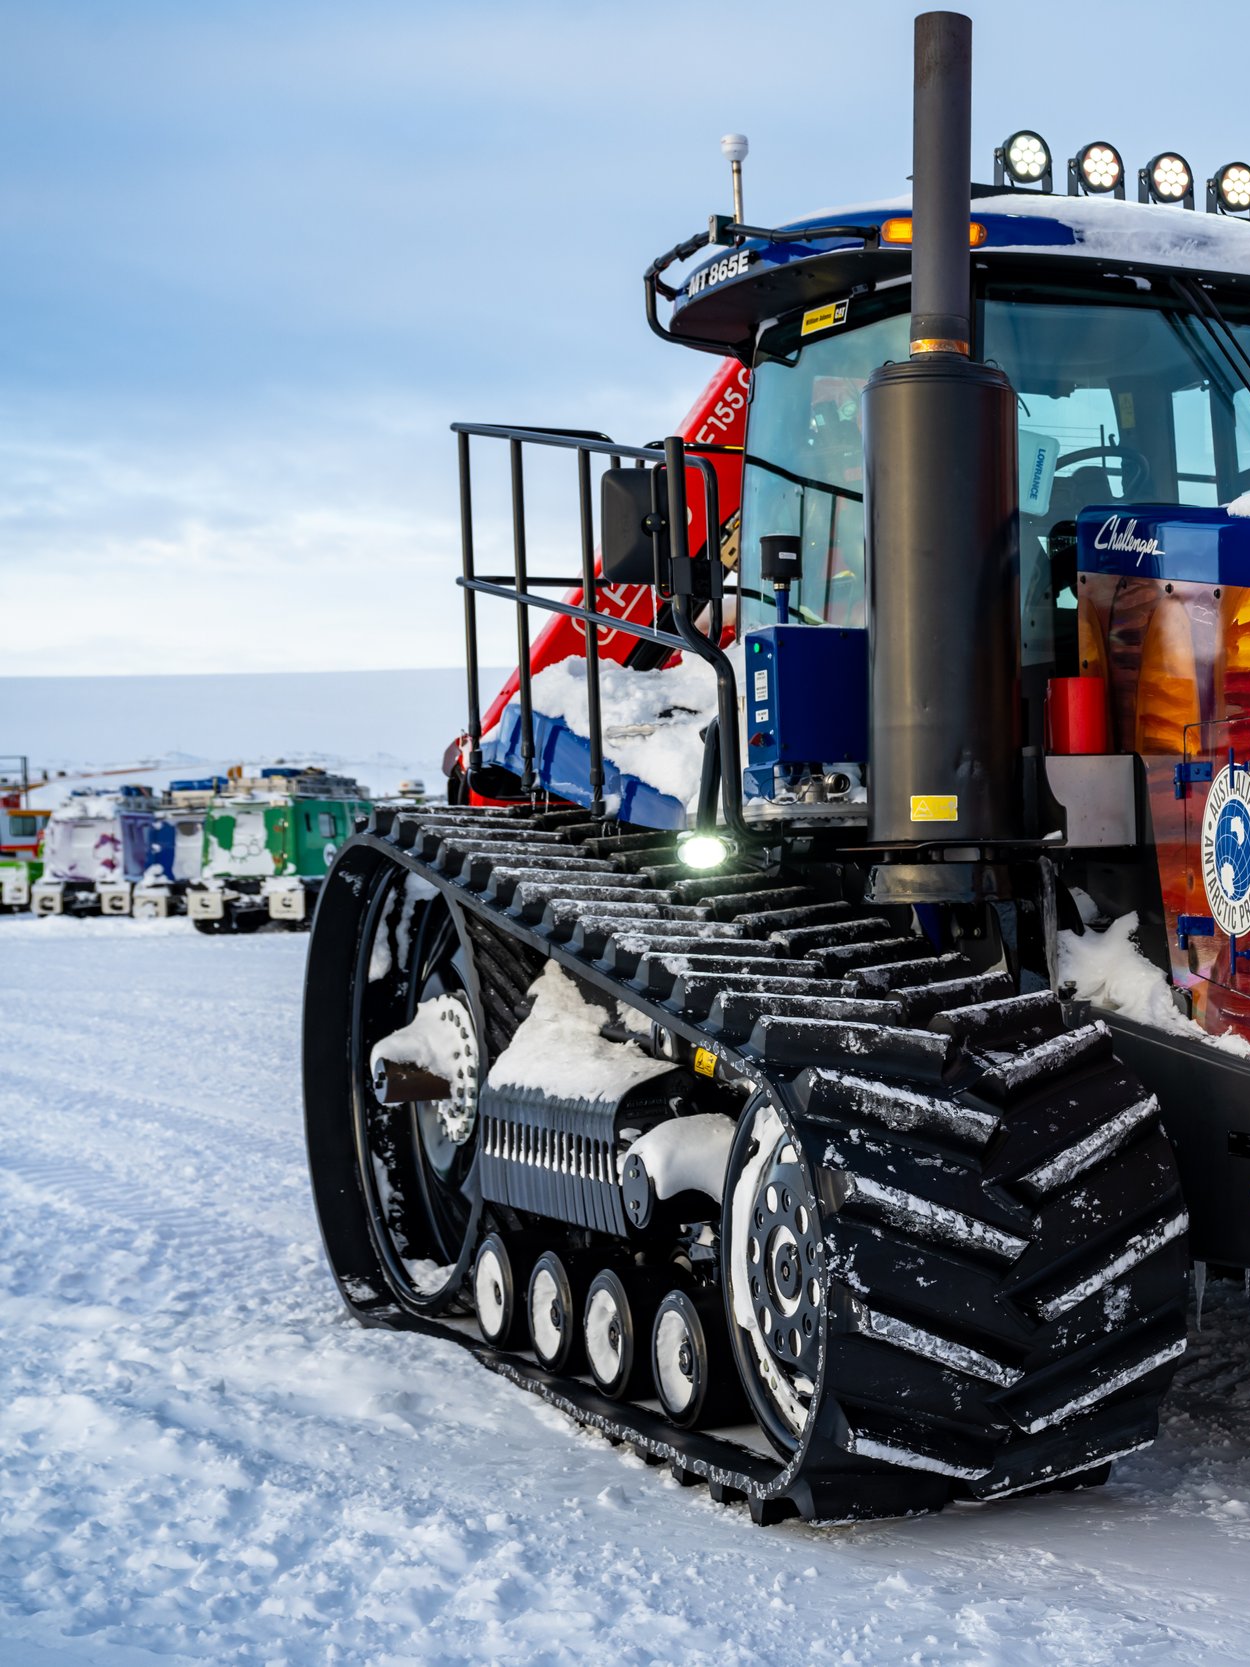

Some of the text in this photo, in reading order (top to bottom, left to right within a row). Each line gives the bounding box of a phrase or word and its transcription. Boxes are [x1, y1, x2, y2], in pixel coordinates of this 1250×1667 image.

[688, 249, 750, 298] MT 865E
[834, 306, 846, 319] CAT
[1029, 447, 1047, 501] LOWRANCE
[1094, 514, 1166, 568] Challenger
[1204, 838, 1237, 930] ANTARCTIC
